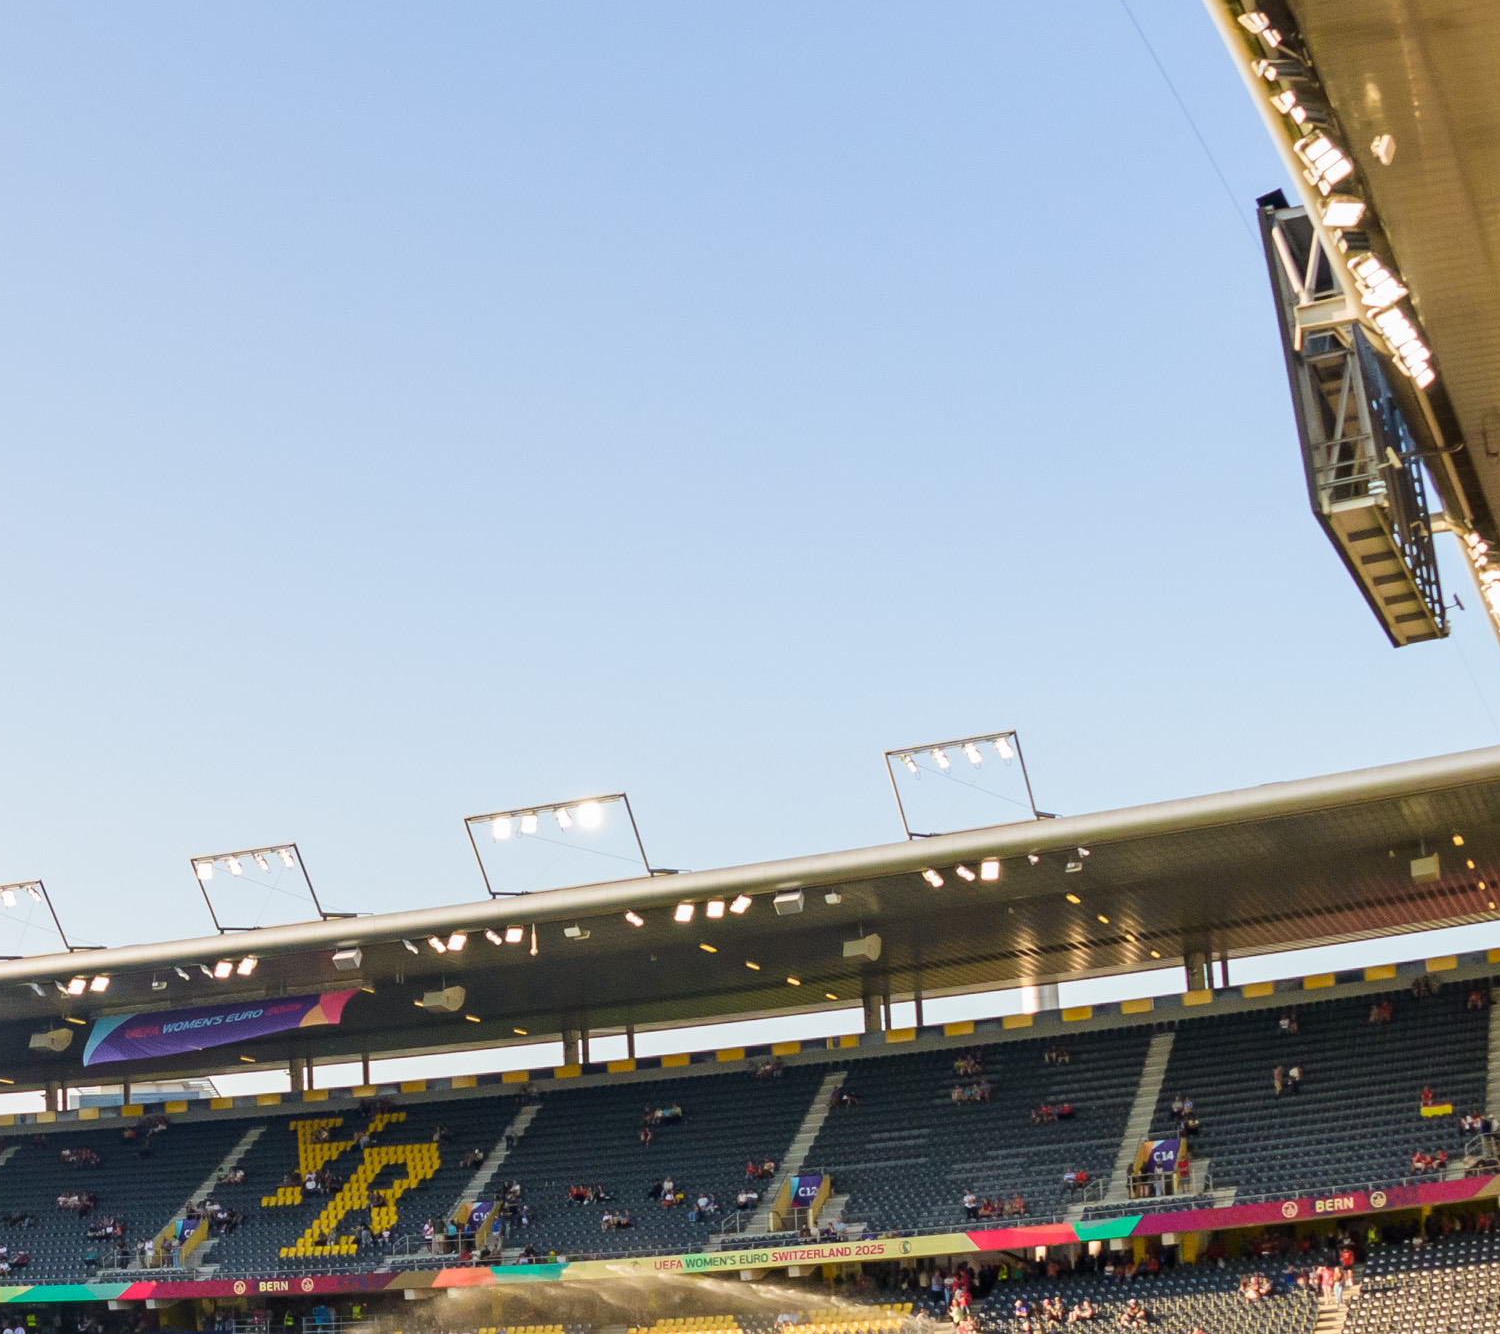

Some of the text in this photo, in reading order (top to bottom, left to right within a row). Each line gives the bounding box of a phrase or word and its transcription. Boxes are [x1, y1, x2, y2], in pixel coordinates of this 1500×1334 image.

[162, 1015, 223, 1034] WOMEN'S
[226, 1009, 263, 1023] EURO
[1153, 1150, 1174, 1161] C14
[1315, 1197, 1354, 1212] BERN
[654, 1244, 885, 1270] UEFA WOMEN'S EURO SWITZERLAND 2025
[259, 1280, 289, 1292] BERN
